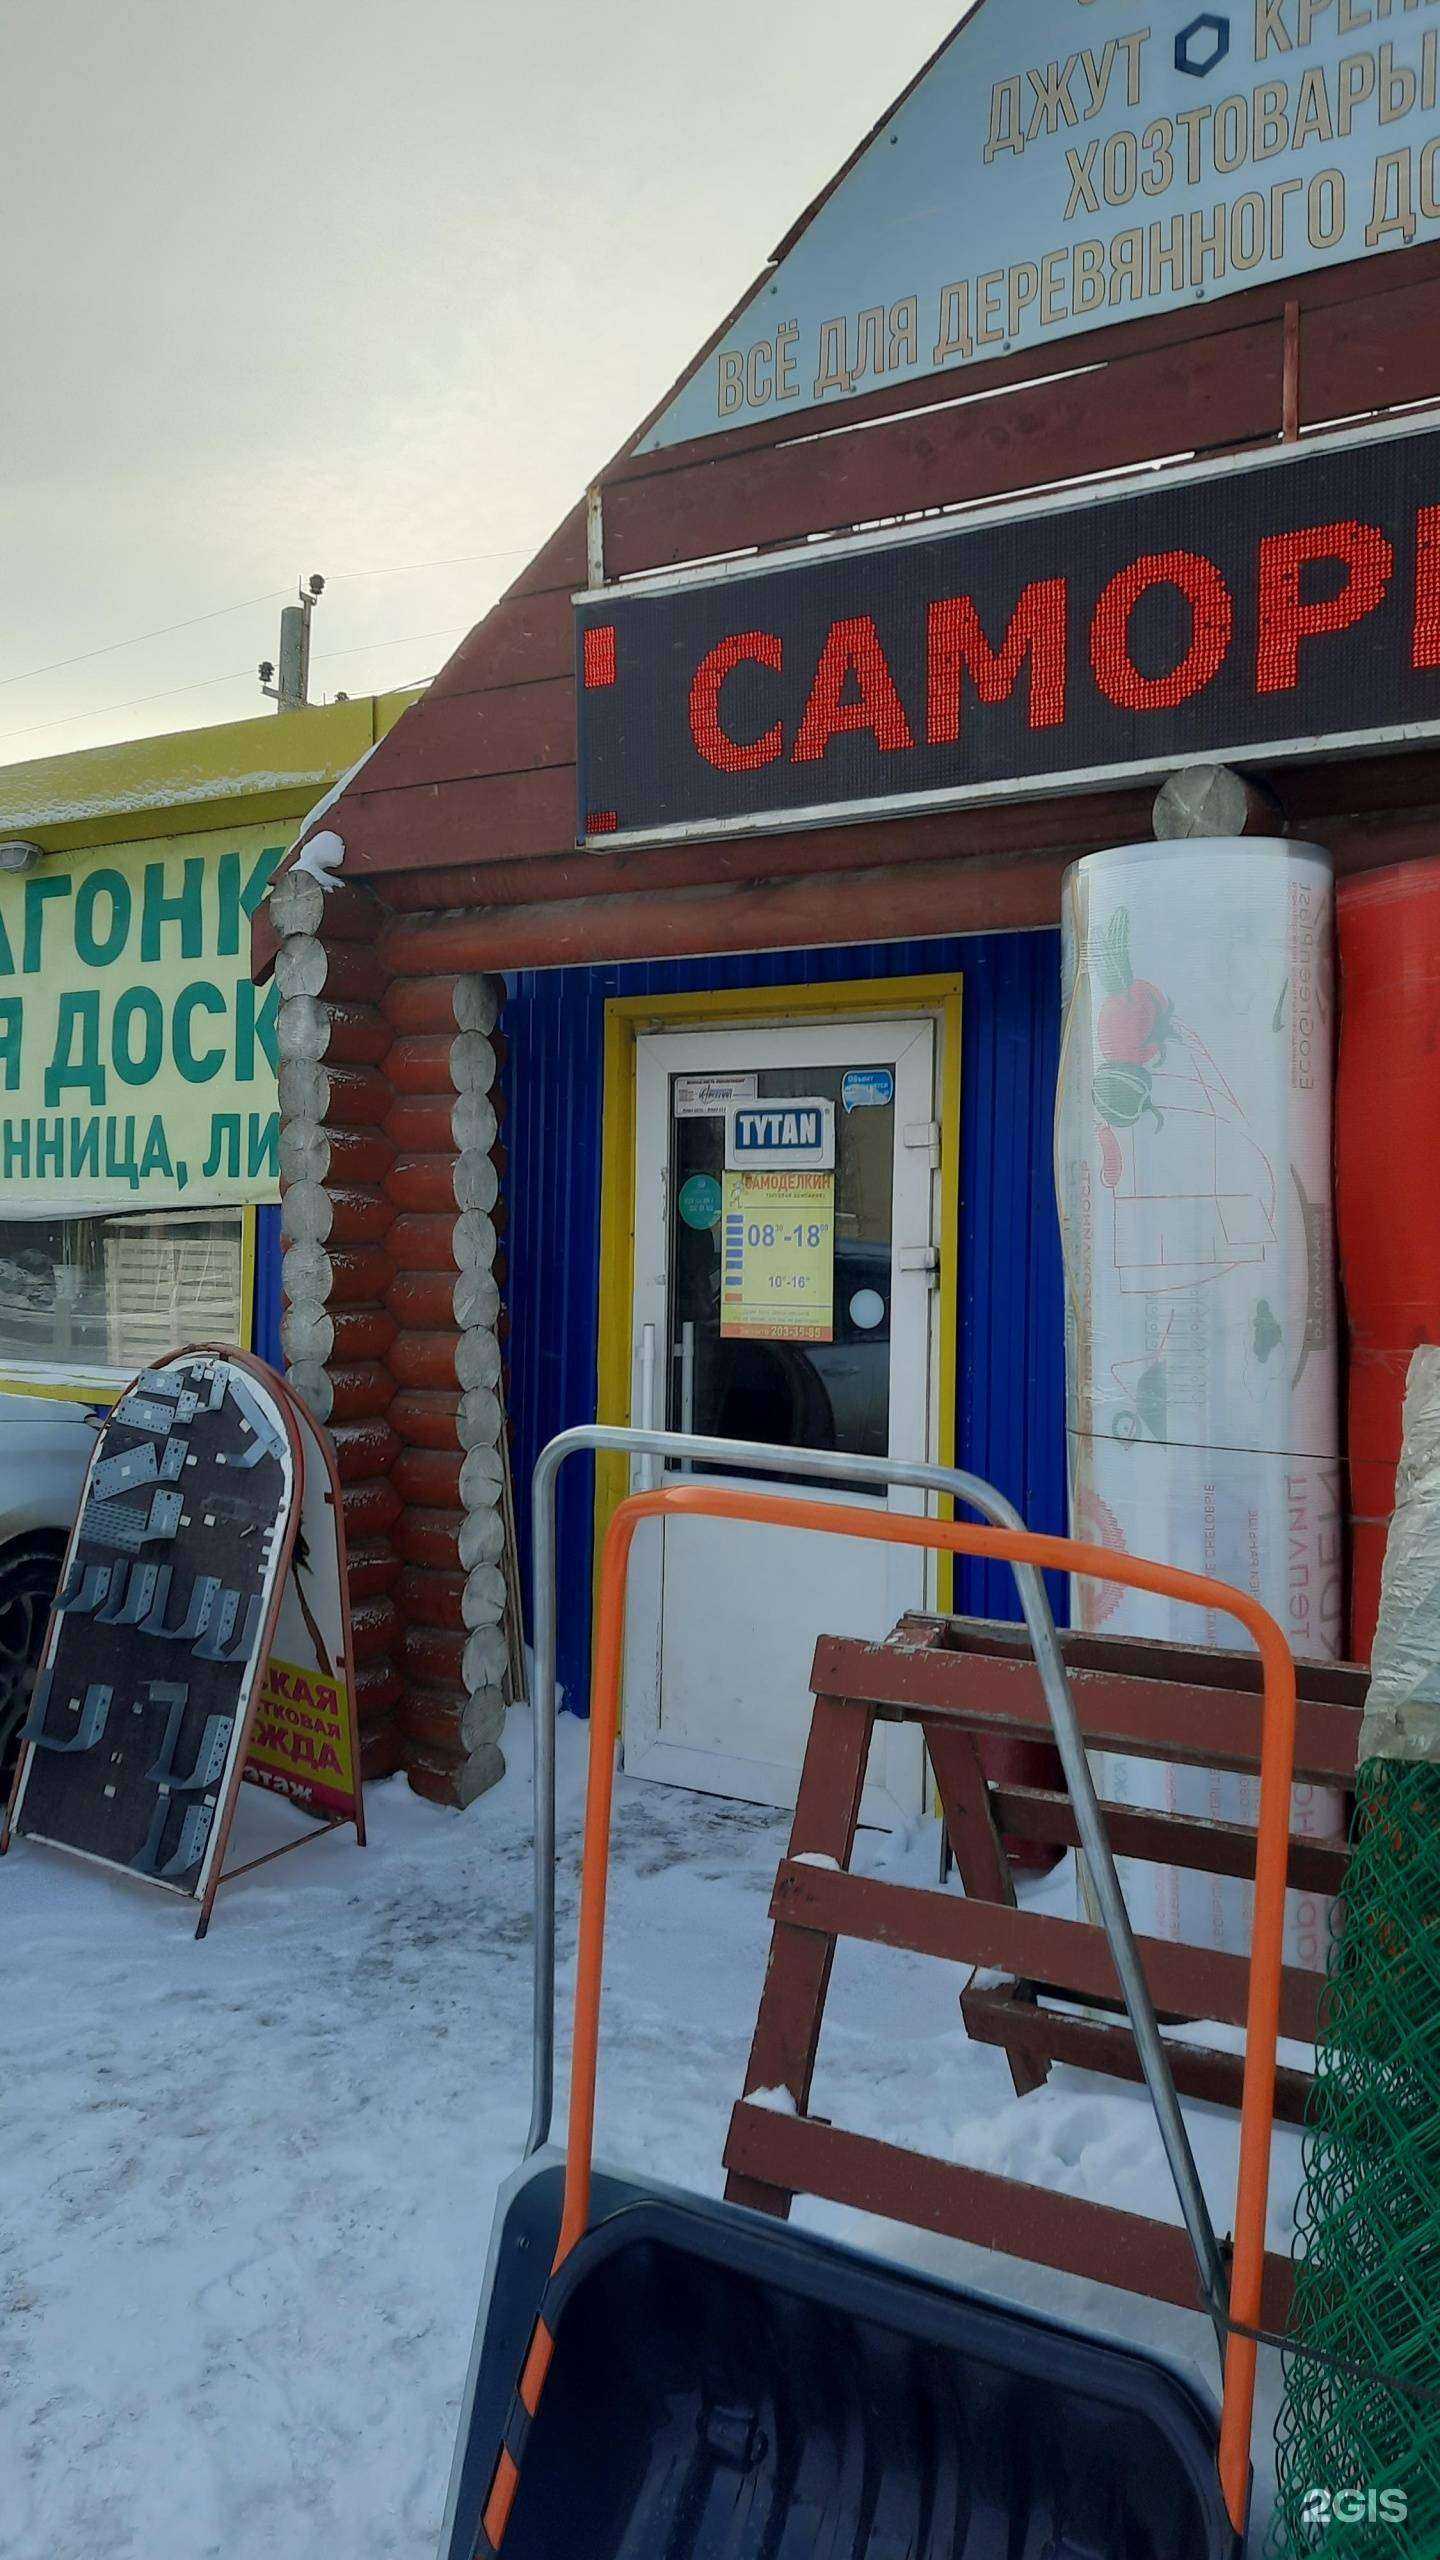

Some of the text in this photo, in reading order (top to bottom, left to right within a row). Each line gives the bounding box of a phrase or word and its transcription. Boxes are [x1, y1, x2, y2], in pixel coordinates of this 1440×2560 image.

[984, 27, 1151, 164] ДЖУТ
[1063, 29, 1438, 221] ХОЗТОВАРЫ
[717, 319, 800, 418] ВСЁ
[813, 295, 918, 399] ДЛЯ
[933, 168, 1346, 365] ДЕРЕВЯННОГО
[0, 846, 286, 976] ГОНК
[739, 1113, 817, 1146] TYTAN
[745, 1173, 832, 1192] САМОДЕЛКИН
